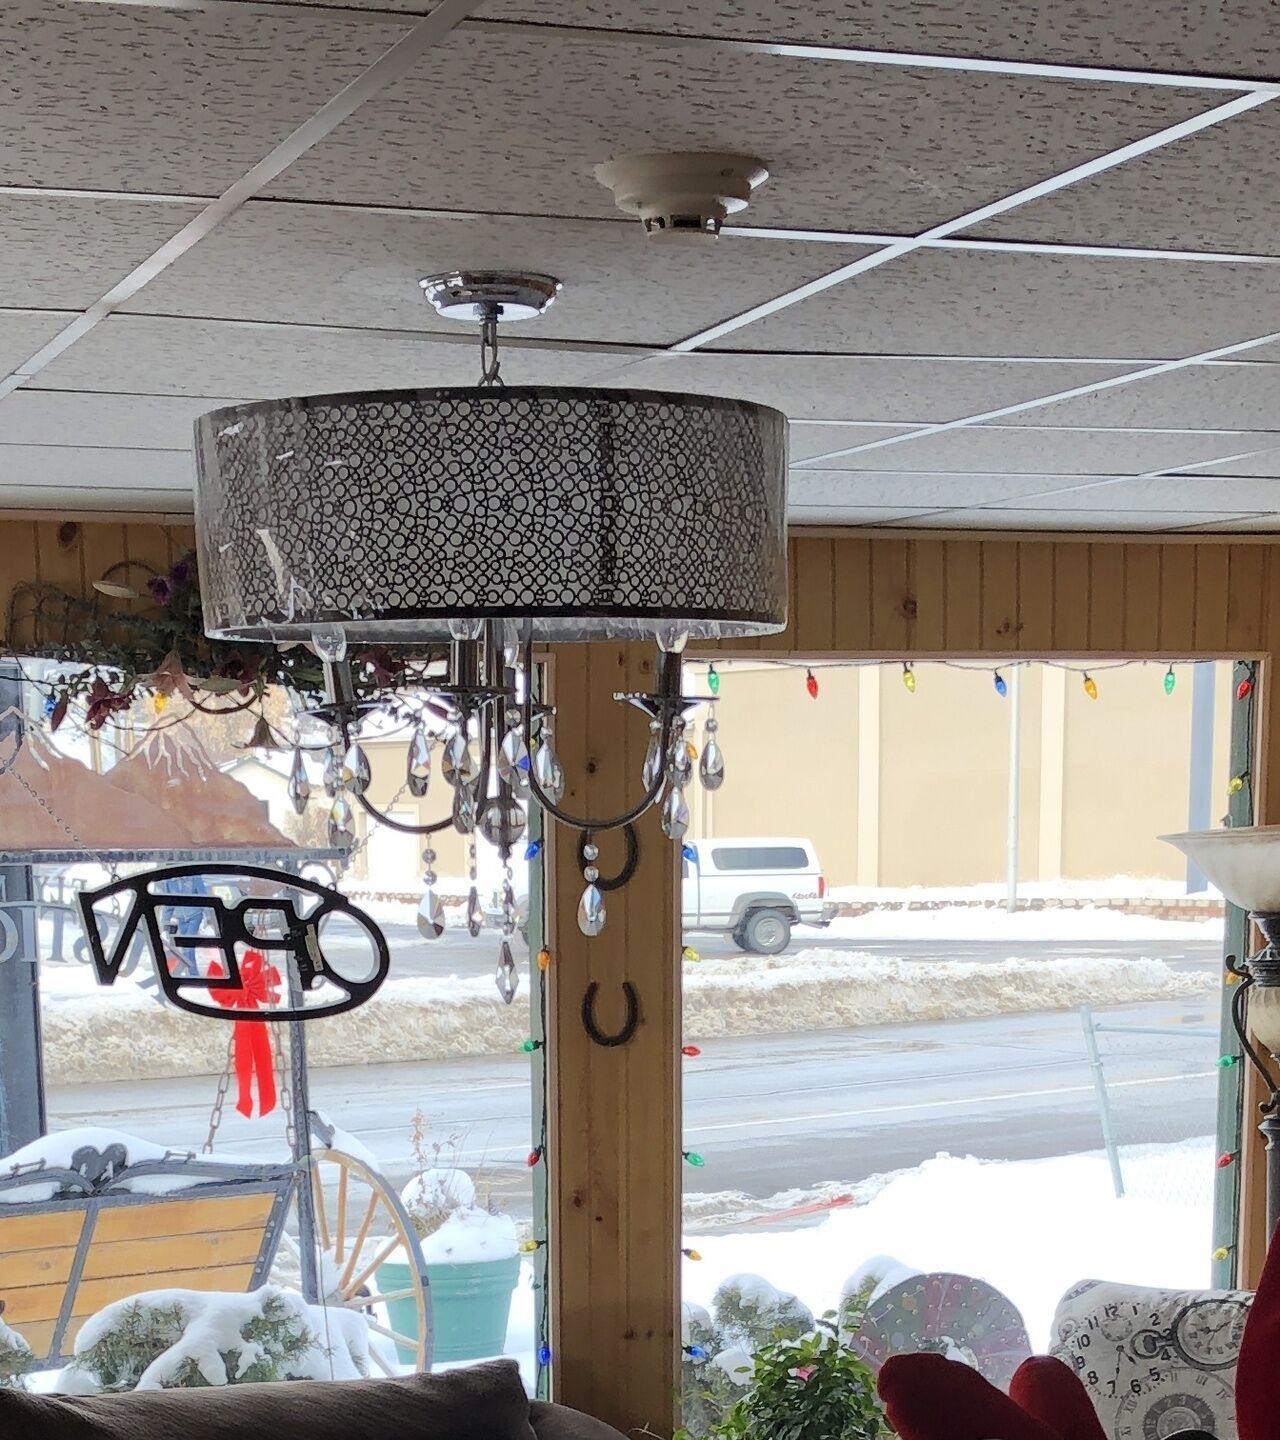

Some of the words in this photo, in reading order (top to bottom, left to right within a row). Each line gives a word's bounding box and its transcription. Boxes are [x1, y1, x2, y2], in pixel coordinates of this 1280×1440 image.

[1149, 1313, 1161, 1326] 2
[1076, 1334, 1091, 1350] 10
[1087, 1371, 1099, 1385] 8
[1149, 1367, 1161, 1381] 5
[1130, 1379, 1141, 1393] 6
